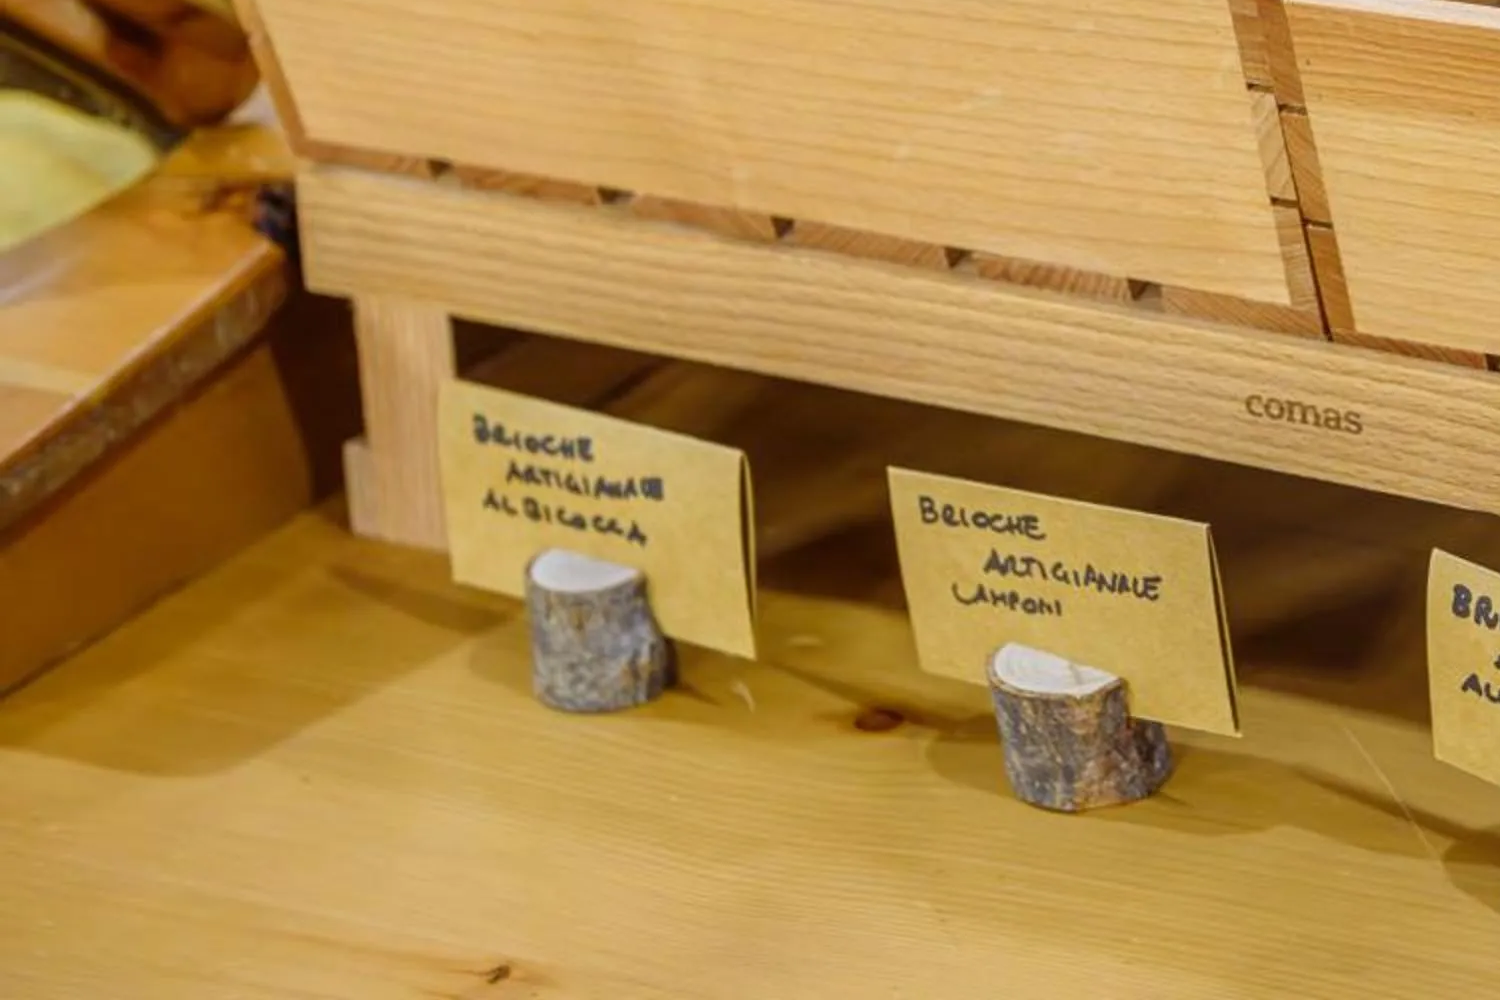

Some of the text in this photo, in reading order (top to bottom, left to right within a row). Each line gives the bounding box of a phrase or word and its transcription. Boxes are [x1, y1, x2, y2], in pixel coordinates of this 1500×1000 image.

[473, 413, 595, 461] BRIOCHE
[1245, 394, 1363, 435] comas
[918, 495, 1047, 540] BRIOCHE
[984, 550, 1162, 601] ARTIGIANALE
[952, 583, 1063, 617] LAMPONI
